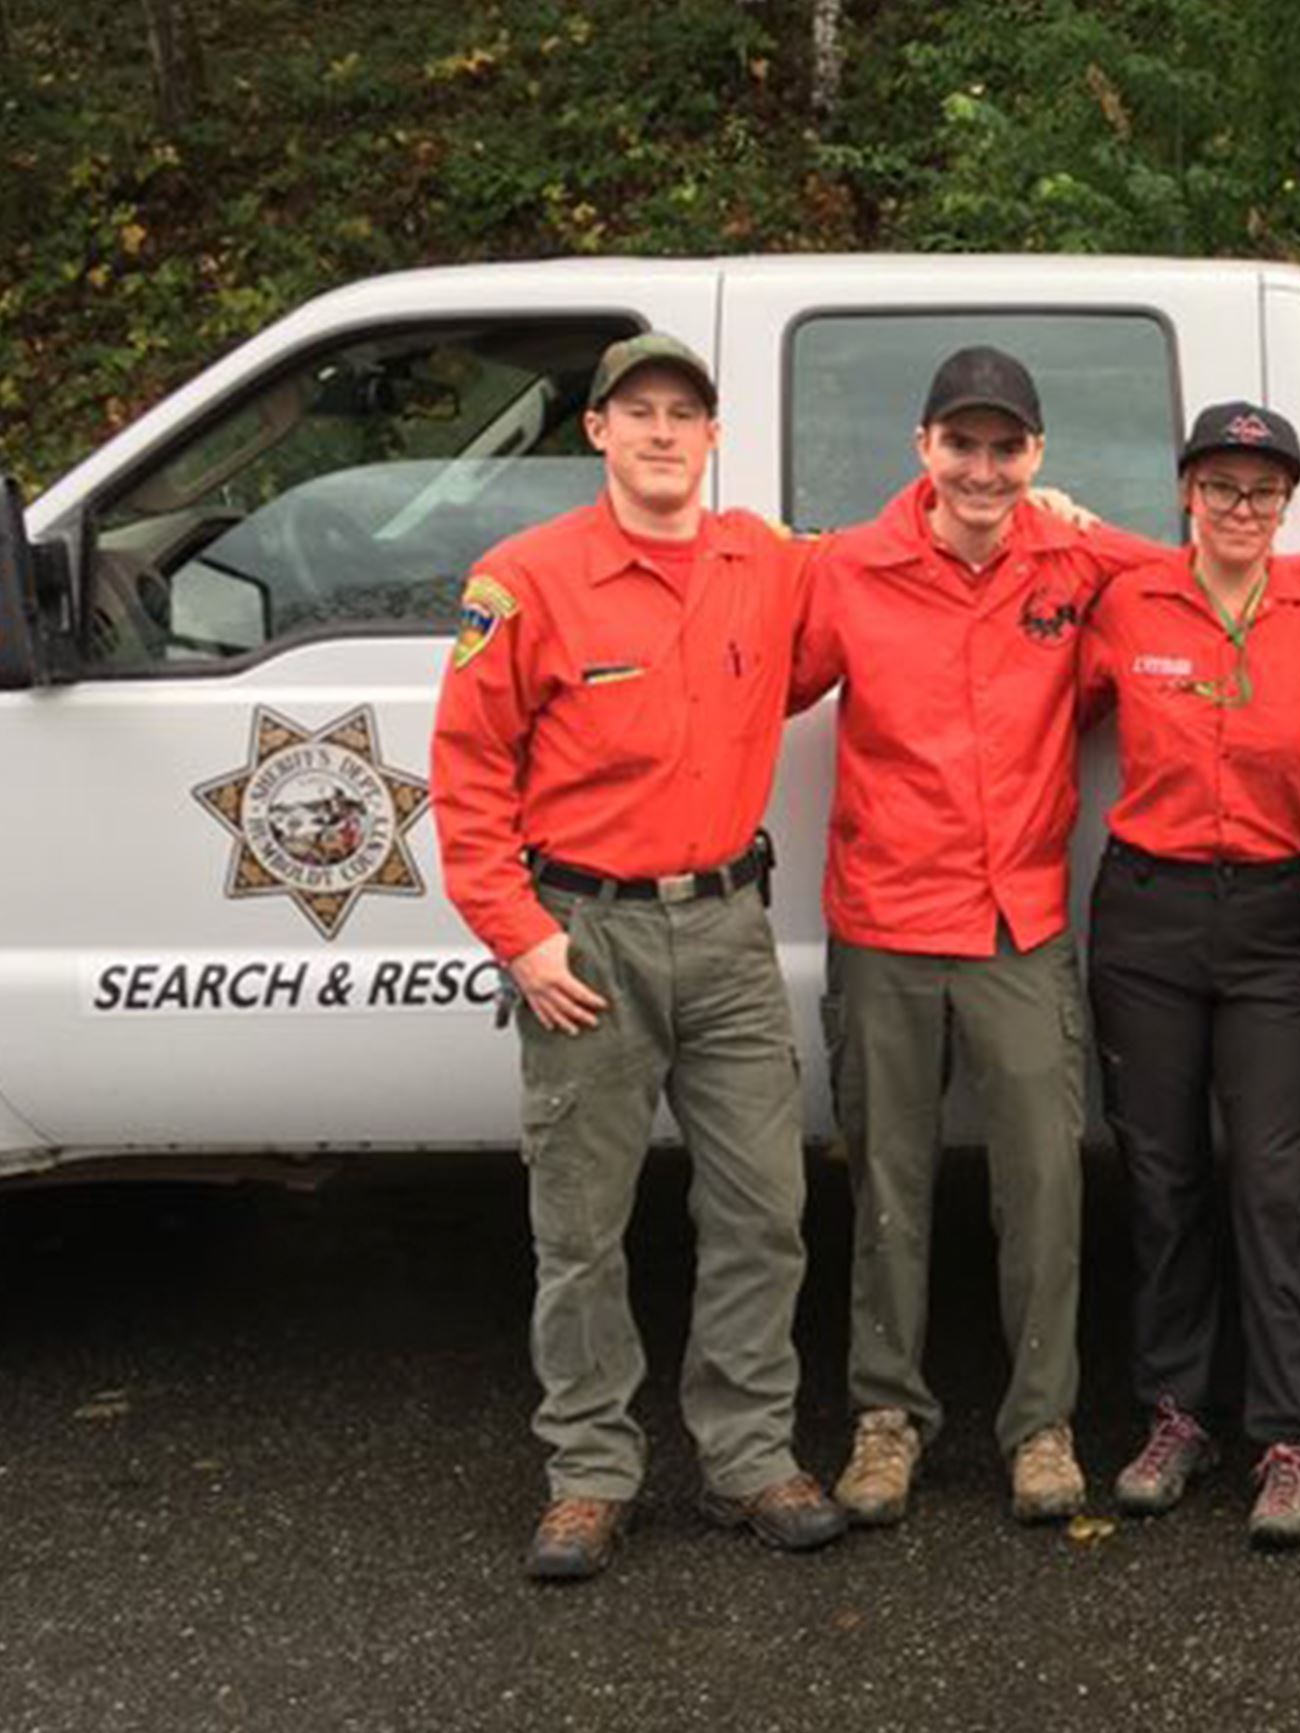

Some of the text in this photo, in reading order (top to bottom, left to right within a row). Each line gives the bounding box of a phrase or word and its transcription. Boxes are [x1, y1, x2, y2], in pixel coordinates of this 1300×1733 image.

[94, 960, 501, 1010] SEARCH & RESC
